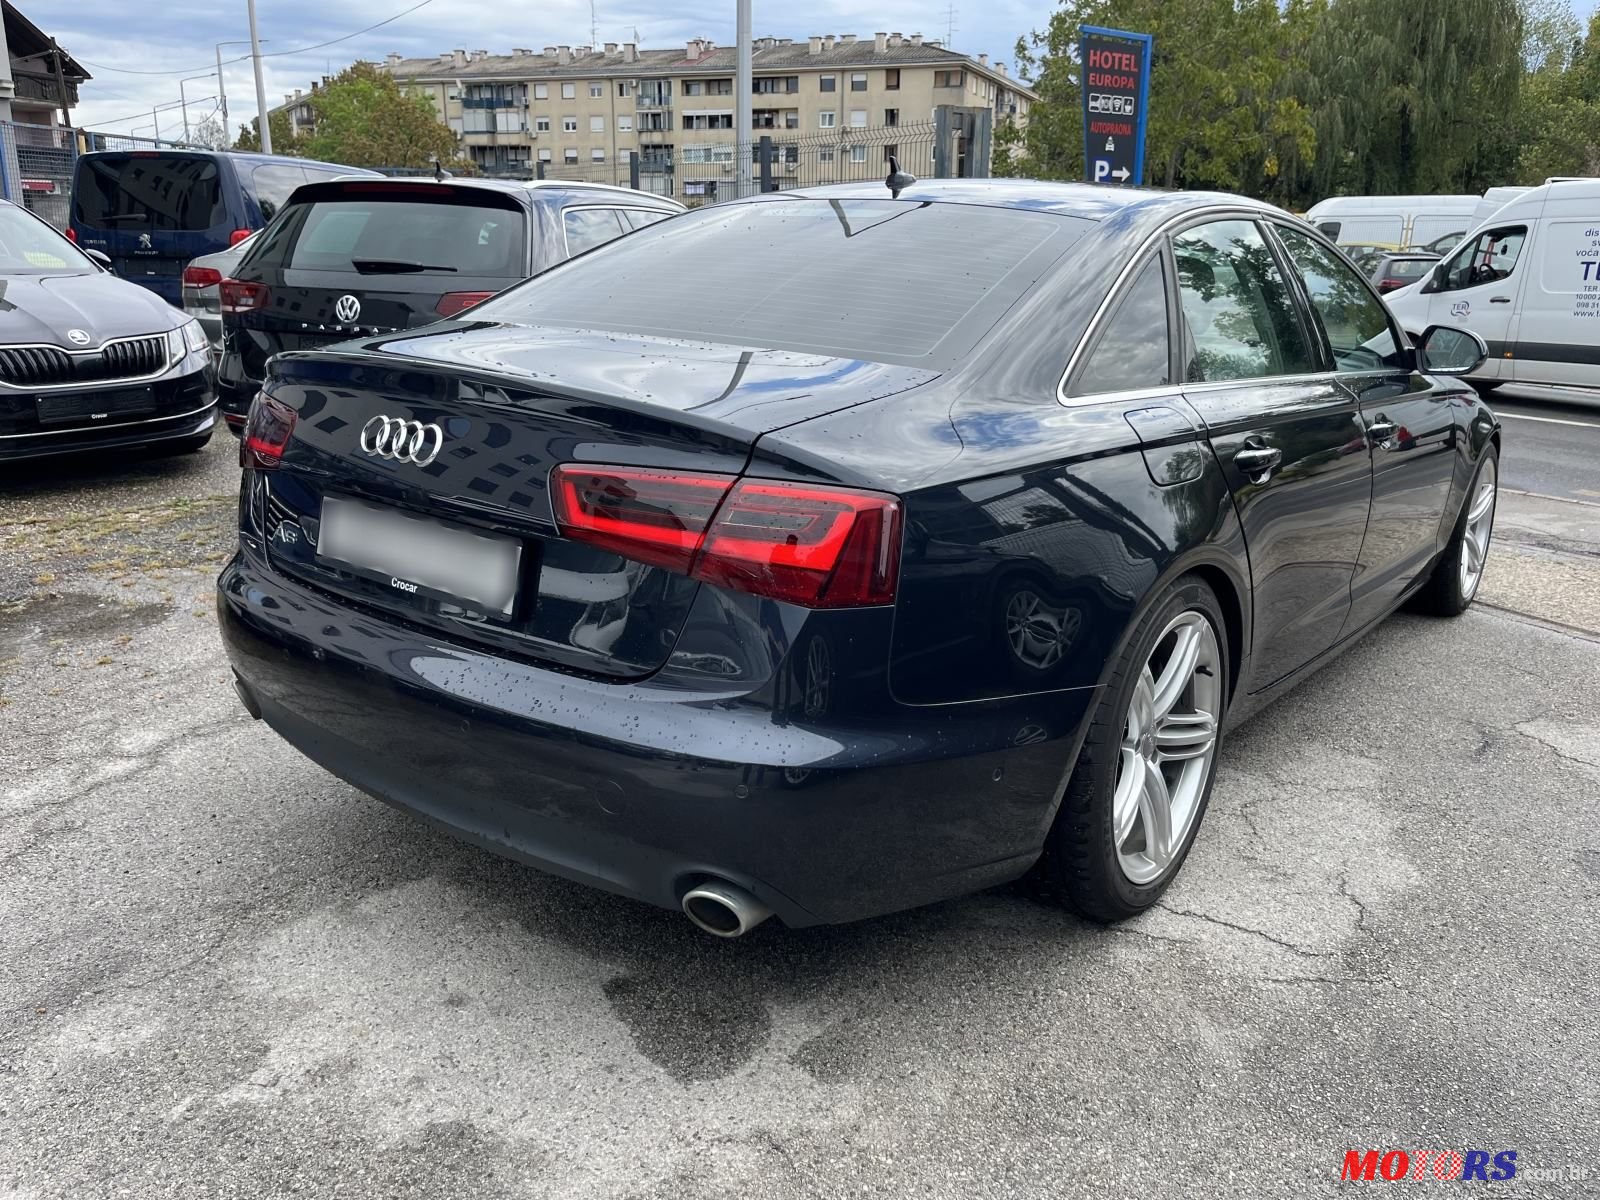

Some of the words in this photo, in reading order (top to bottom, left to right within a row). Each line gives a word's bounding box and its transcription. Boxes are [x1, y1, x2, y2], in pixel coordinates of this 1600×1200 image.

[1089, 49, 1138, 72] HOTEL
[1089, 73, 1135, 89] EUROPA
[1094, 160, 1110, 182] P
[391, 577, 418, 593] Crocar
